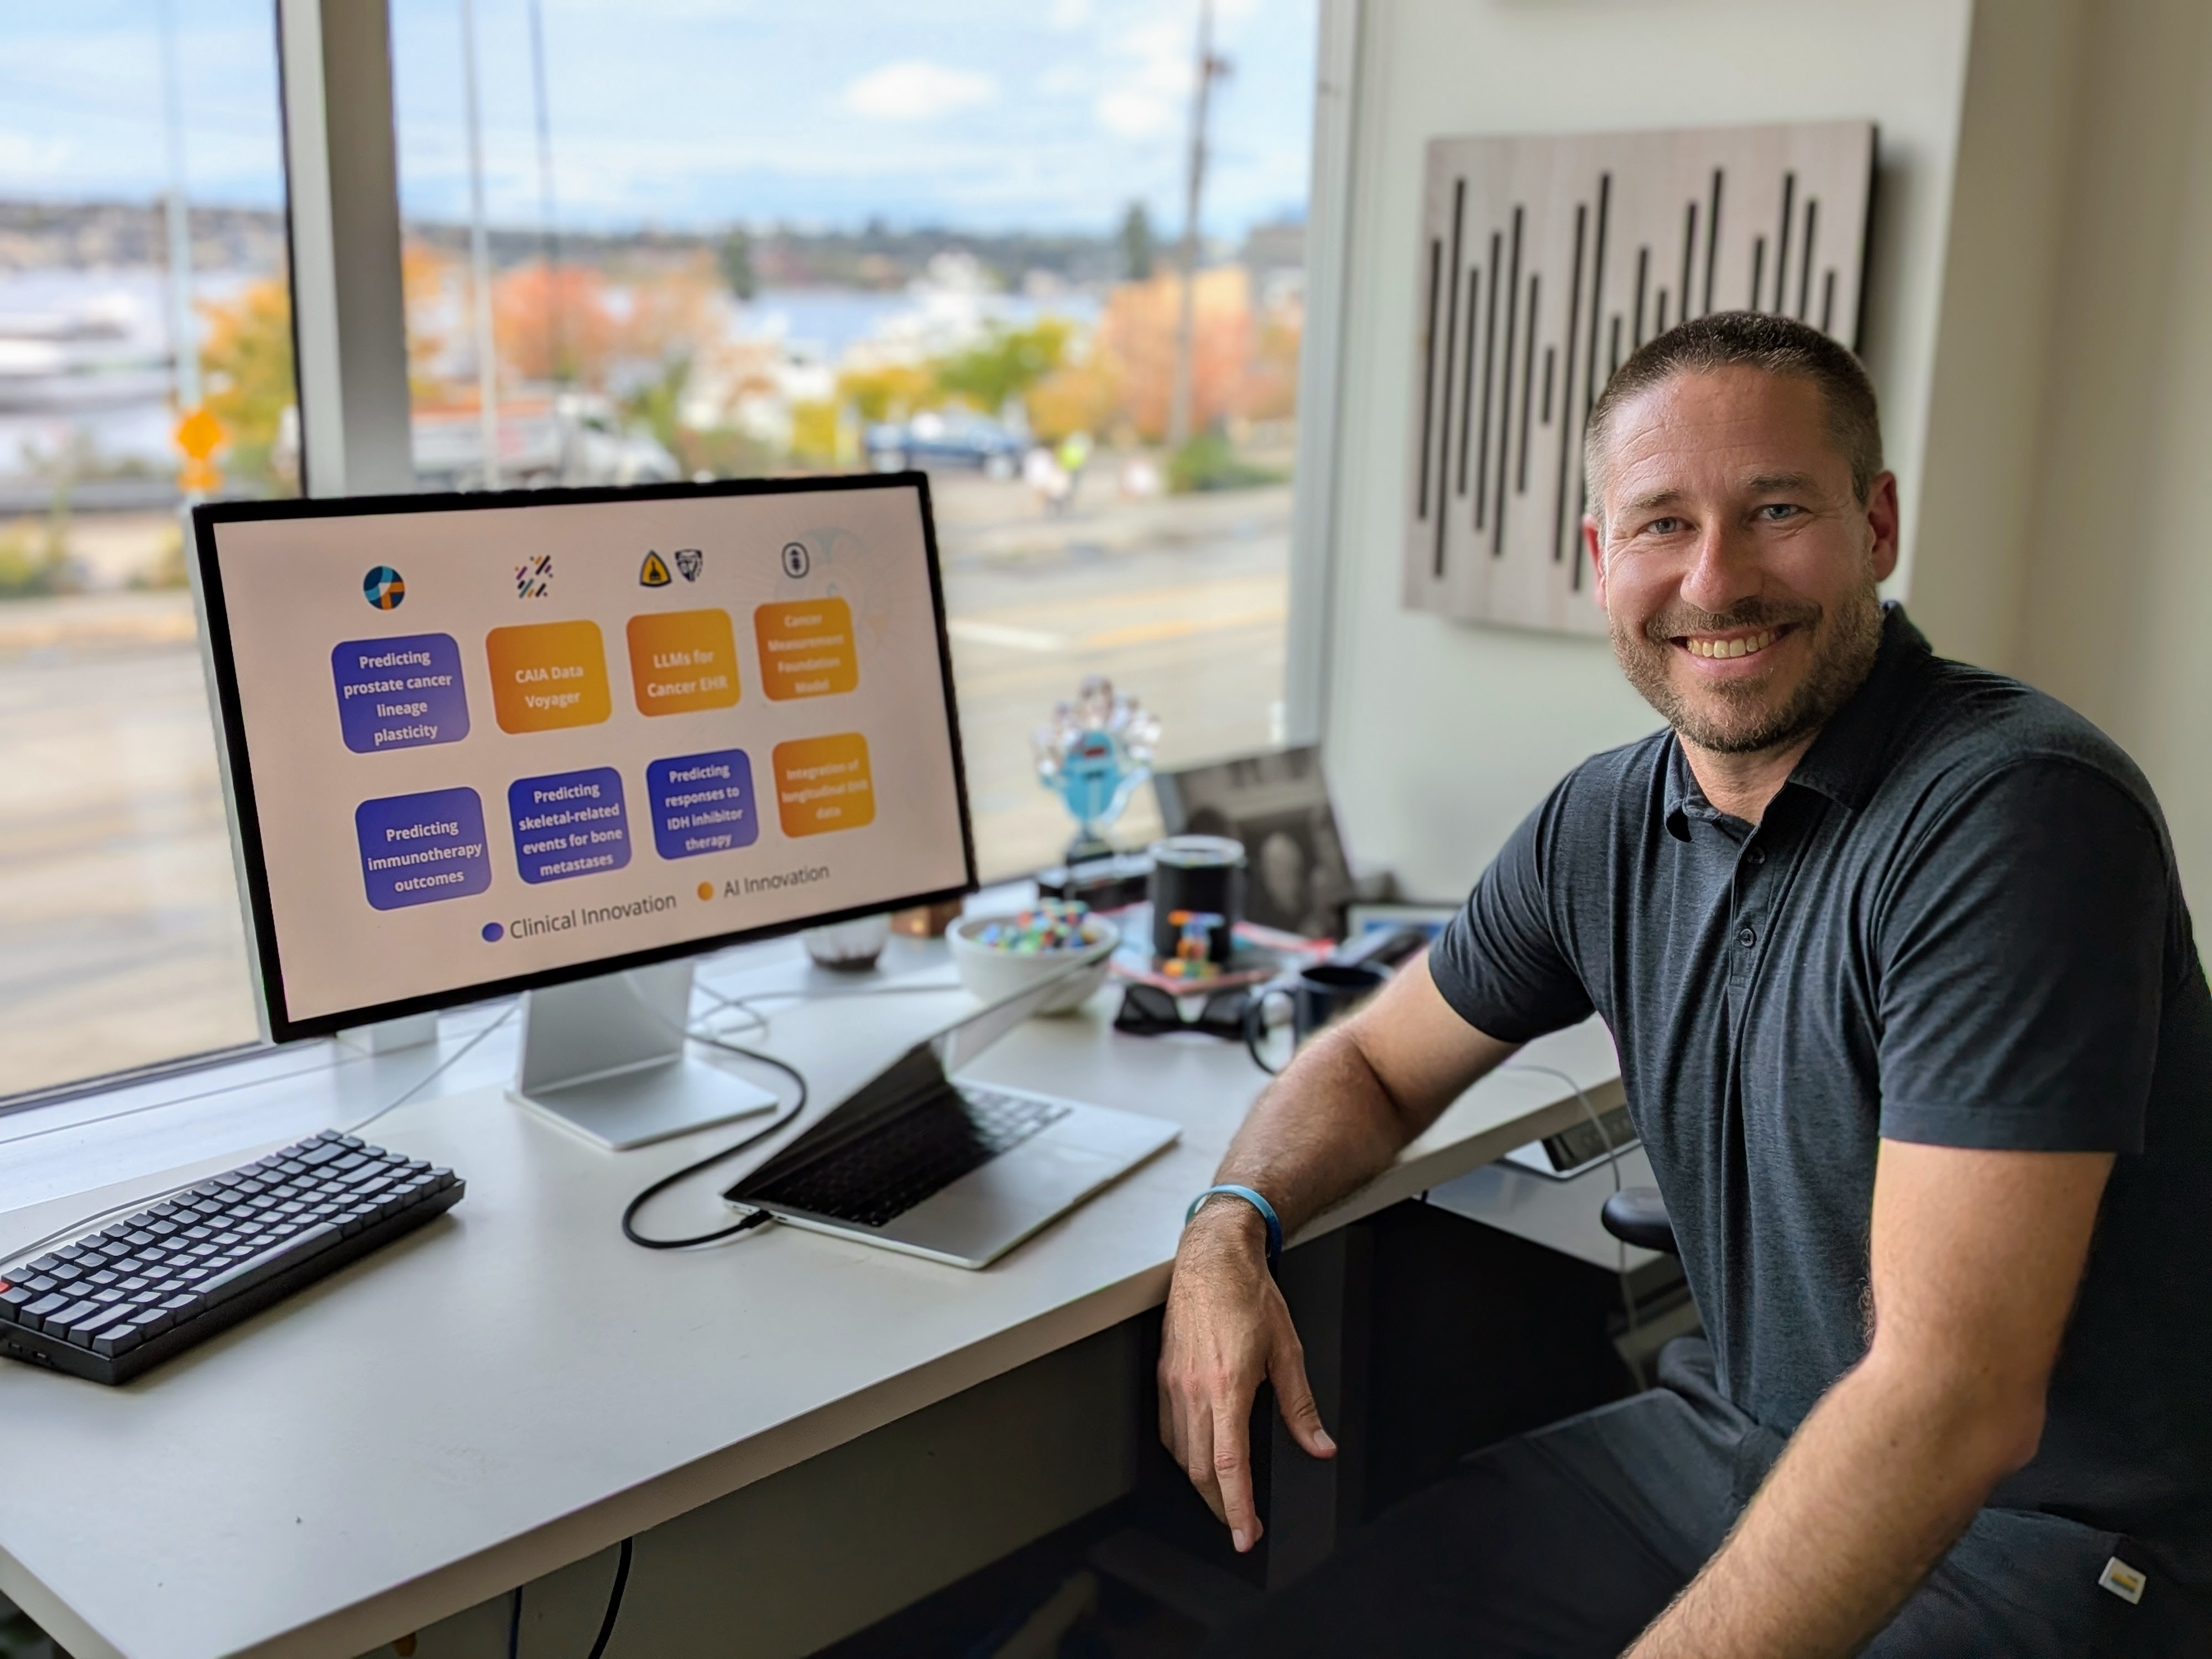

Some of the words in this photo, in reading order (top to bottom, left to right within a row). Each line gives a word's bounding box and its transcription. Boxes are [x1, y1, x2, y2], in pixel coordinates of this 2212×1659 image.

[784, 614, 823, 628] Cancer
[359, 651, 431, 669] Predicting
[653, 652, 691, 669] LLMs
[693, 649, 714, 665] for
[515, 669, 549, 684] CAIA
[552, 666, 583, 679] Data
[343, 679, 403, 699] prostate
[406, 675, 452, 689] cancer
[647, 681, 696, 698] Cancer
[700, 675, 728, 691] EHR
[377, 701, 427, 717] lineage
[525, 692, 580, 709] Voyager
[374, 724, 438, 746] plasticity
[669, 764, 731, 783] Predicting
[848, 758, 859, 771] of
[534, 783, 600, 804] Predicting
[665, 789, 724, 807] responses
[727, 787, 740, 799] to
[519, 803, 620, 831] skeletal-related
[667, 815, 690, 831] IDH
[692, 808, 743, 826] inhibitor
[816, 807, 841, 820] data
[386, 821, 459, 842] Predicting
[523, 837, 567, 855] events
[569, 834, 588, 847] for
[591, 828, 623, 843] bone
[685, 833, 732, 851] therapy
[368, 843, 482, 871] immunotherapy
[540, 854, 613, 876] metastases
[394, 871, 465, 892] outcomes
[723, 880, 740, 898] AI
[745, 863, 830, 894] Innovation
[510, 910, 576, 940] Clinical
[582, 894, 676, 926] Innovation
